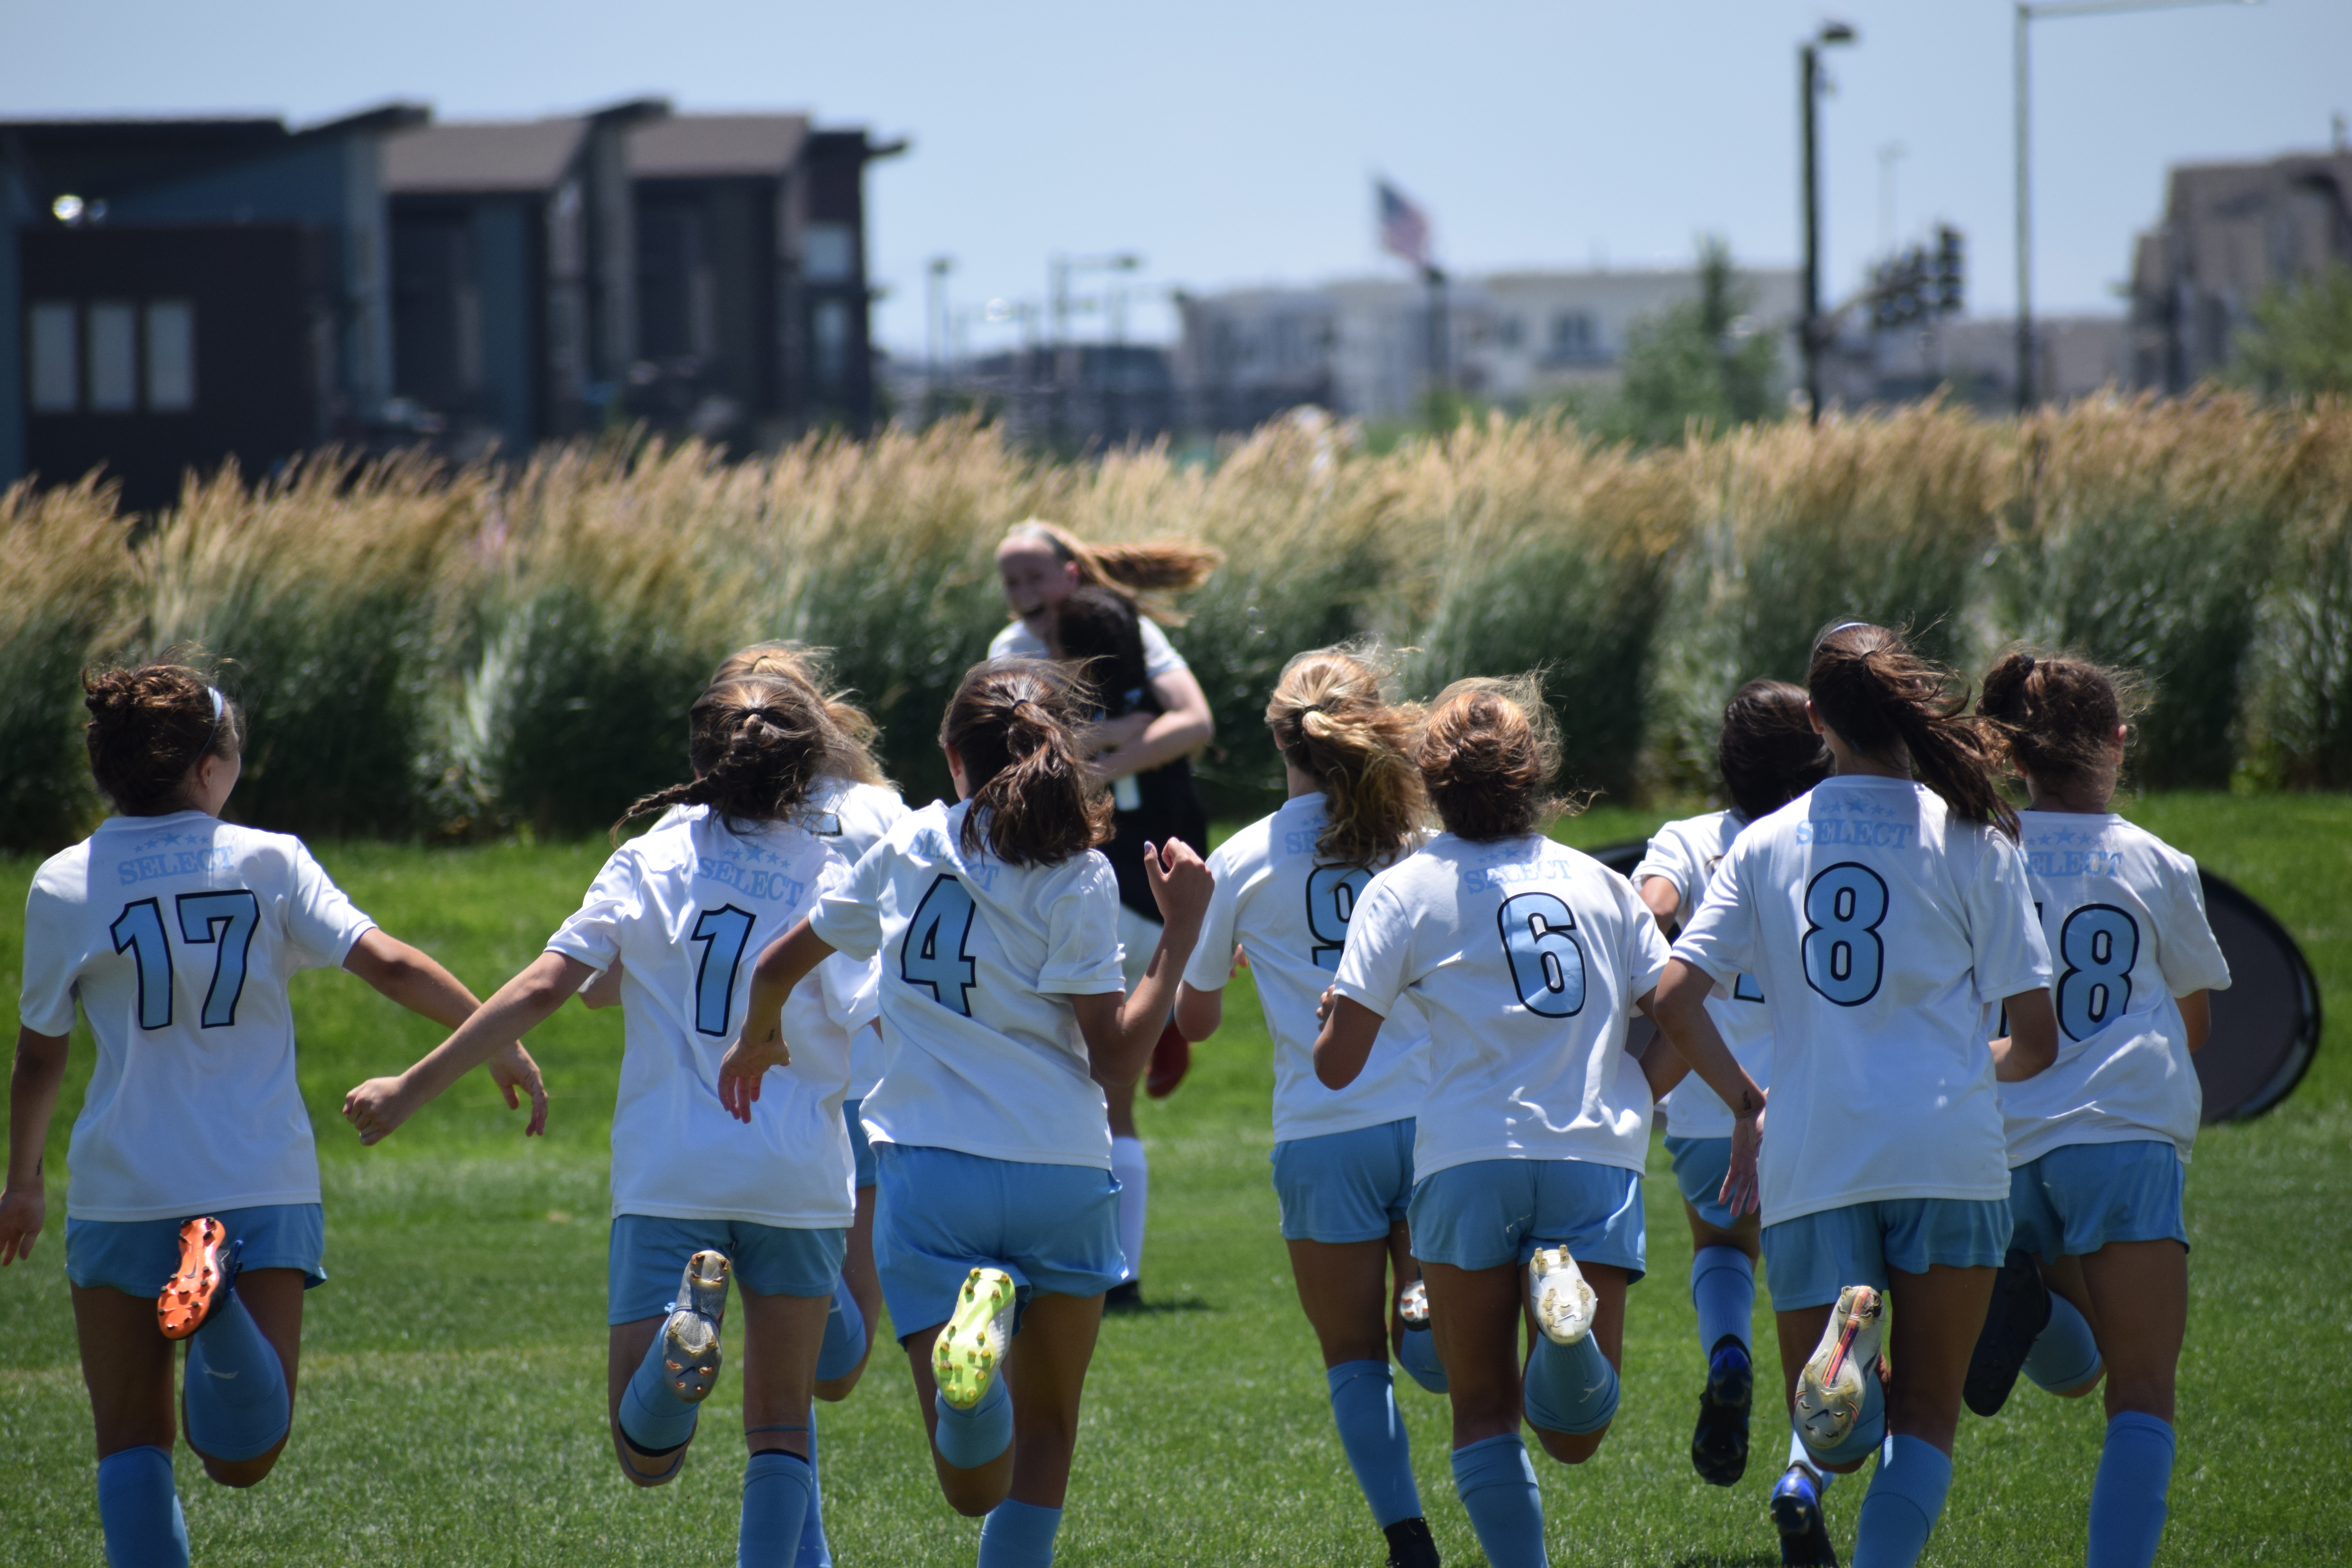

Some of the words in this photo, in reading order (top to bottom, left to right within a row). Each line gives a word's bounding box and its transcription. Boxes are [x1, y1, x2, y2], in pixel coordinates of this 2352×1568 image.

[117, 846, 234, 886] SELECT
[907, 828, 1000, 892] SECT
[1796, 818, 1914, 849] SELECT
[2019, 850, 2122, 877] ELECT
[694, 857, 804, 907] SELECT
[1306, 862, 1376, 972] 9
[1464, 860, 1572, 895] SELECT
[110, 889, 260, 1031] 17
[690, 903, 757, 1038] 1
[901, 873, 976, 1017] 4
[1497, 892, 1586, 1018] 6
[1802, 862, 1889, 1007] 8
